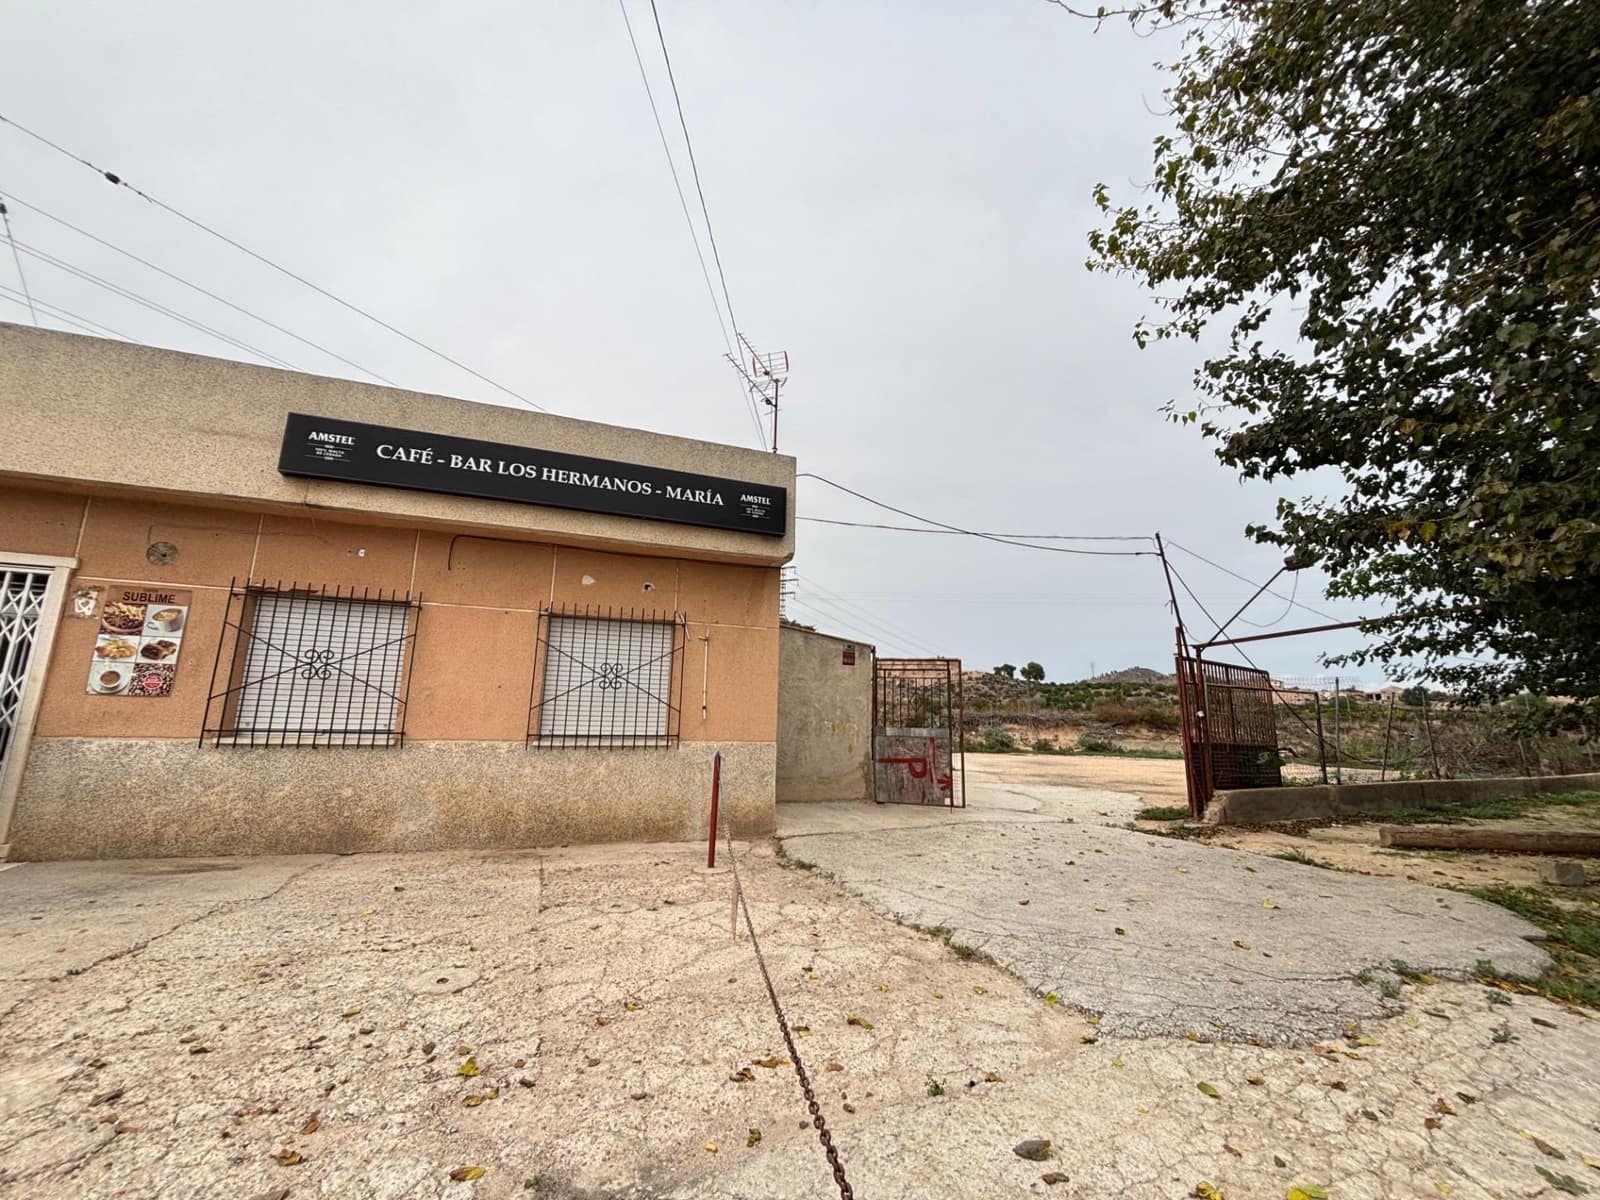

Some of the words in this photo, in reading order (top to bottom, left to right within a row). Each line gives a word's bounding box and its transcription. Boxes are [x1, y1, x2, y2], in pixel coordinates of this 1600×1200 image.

[308, 431, 355, 445] AMSTEL
[376, 444, 433, 464] CAFÉ
[450, 454, 493, 472] BAR
[497, 460, 536, 478] LOS
[541, 467, 652, 495] HERMANOS
[665, 486, 724, 505] MARÍA
[740, 494, 771, 505] AMSTEL
[122, 591, 176, 604] SUBLIME
